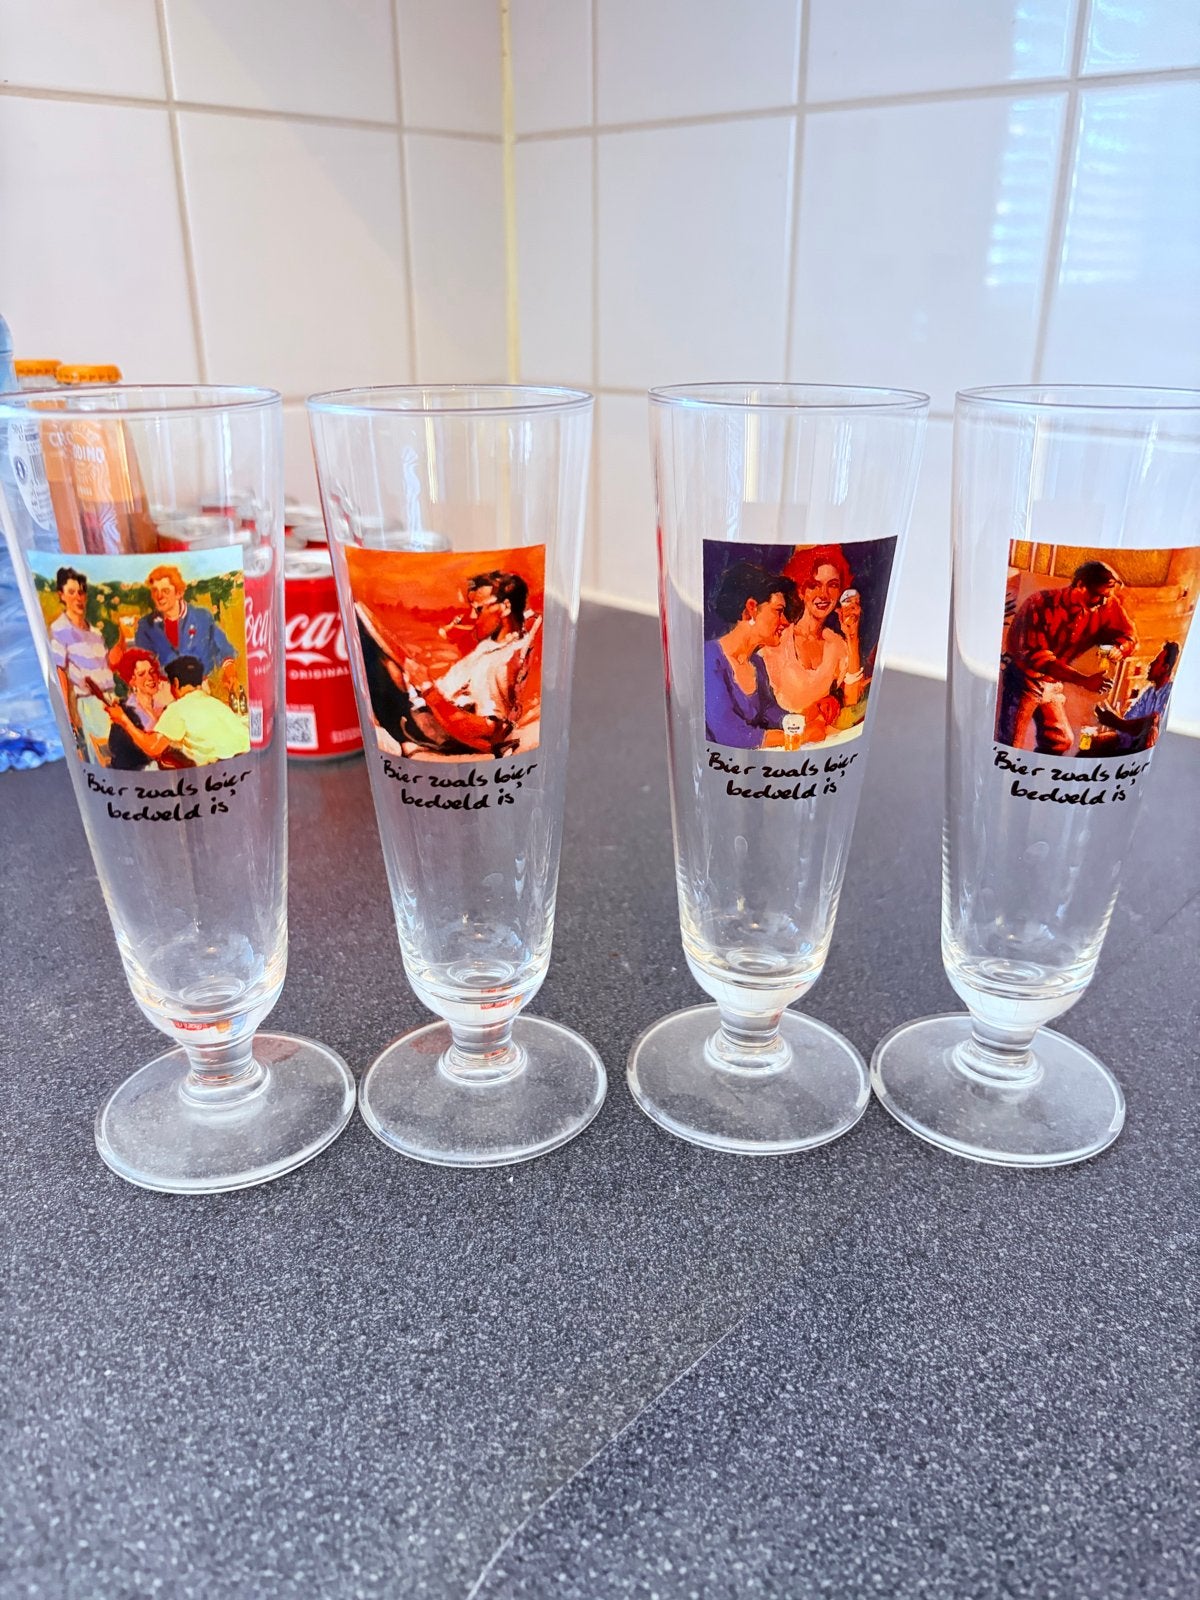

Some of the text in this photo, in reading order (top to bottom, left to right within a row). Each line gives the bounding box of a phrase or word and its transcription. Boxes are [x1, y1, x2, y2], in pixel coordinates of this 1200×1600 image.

[428, 768, 488, 788] zoals
[494, 763, 539, 784] bier
[761, 758, 819, 778] zoals
[824, 753, 859, 773] bier
[1050, 763, 1110, 782] zoals
[1114, 761, 1151, 780] bier
[135, 778, 198, 798] zoals
[205, 770, 252, 792] bier
[726, 780, 817, 800] bedoeld
[1010, 780, 1107, 805] bedoeld
[107, 802, 202, 821] bedoeld
[401, 788, 491, 811] bedoeld
